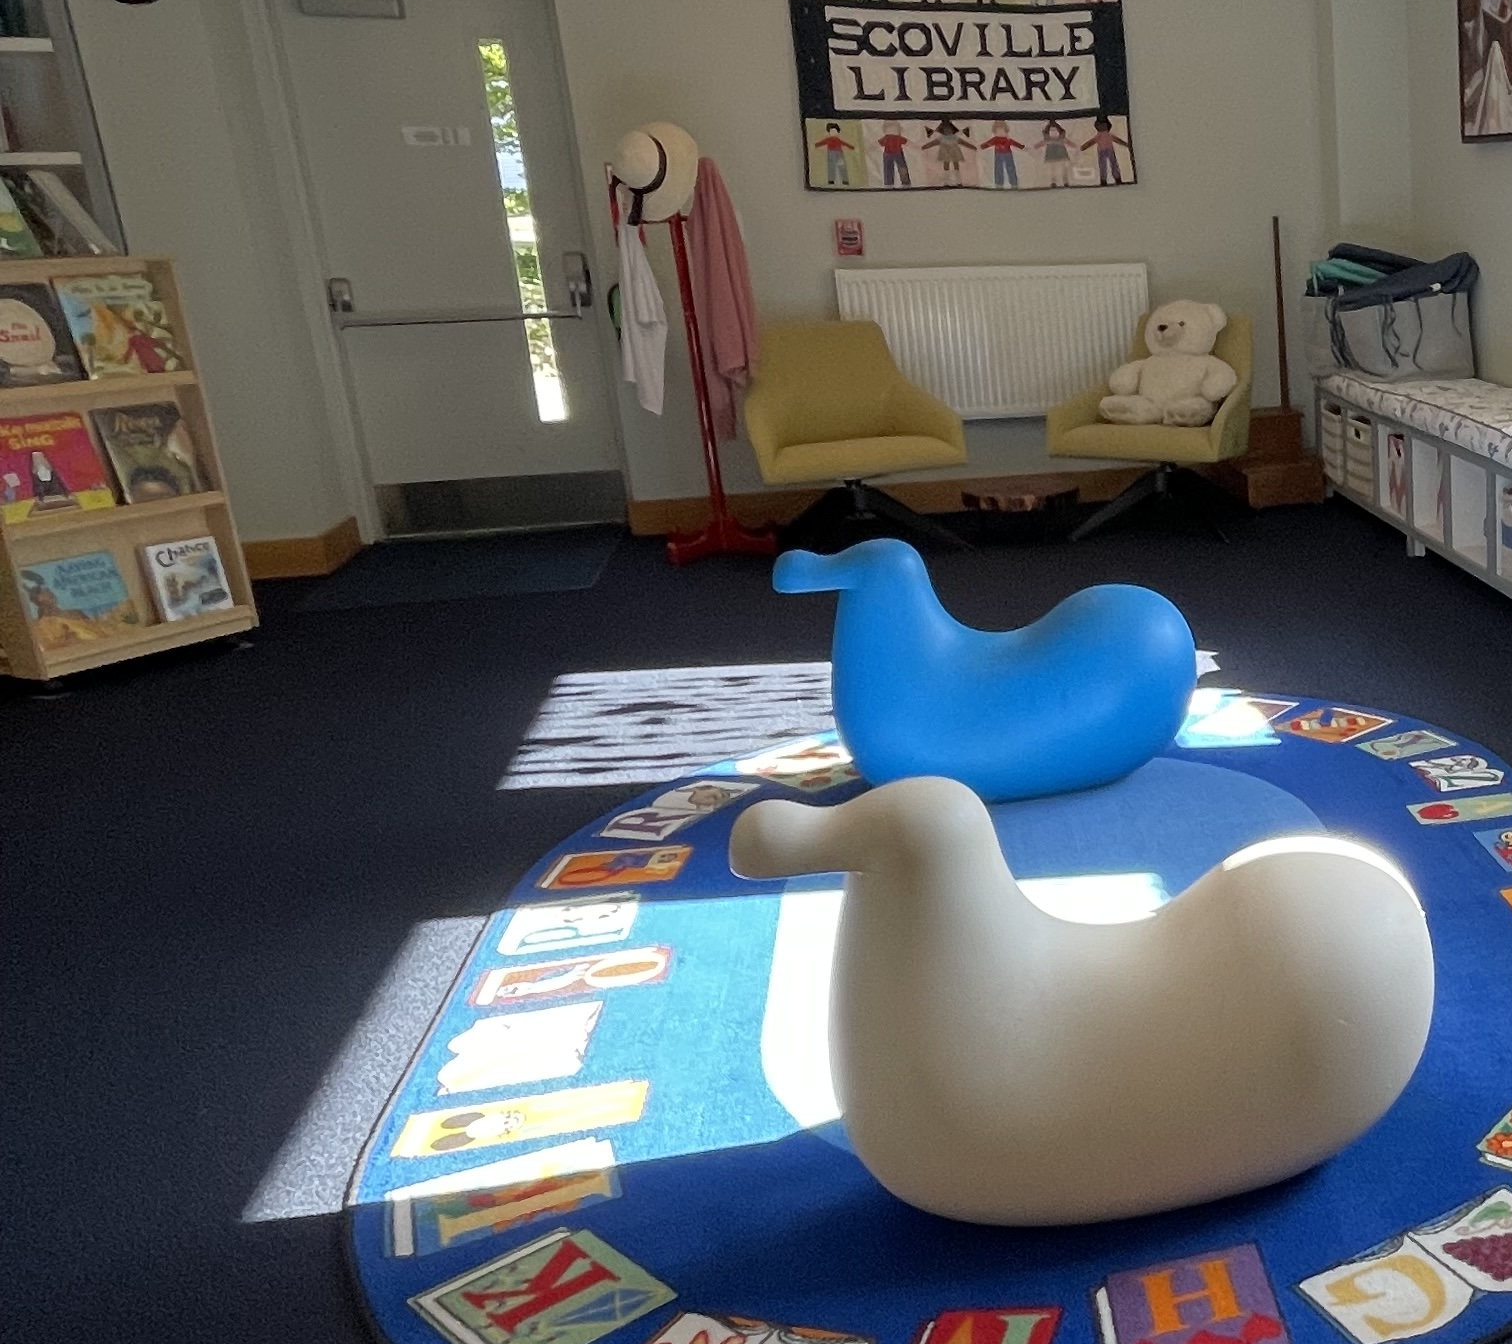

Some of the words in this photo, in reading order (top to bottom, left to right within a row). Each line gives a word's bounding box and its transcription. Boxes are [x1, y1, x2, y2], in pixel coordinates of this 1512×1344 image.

[828, 18, 1095, 57] SCOVILLE
[847, 65, 1080, 102] LIBRARY
[0, 327, 42, 343] Snail
[155, 540, 211, 568] Chance
[461, 1238, 622, 1334] K
[1138, 1261, 1244, 1339] H
[1325, 1258, 1448, 1338] G
